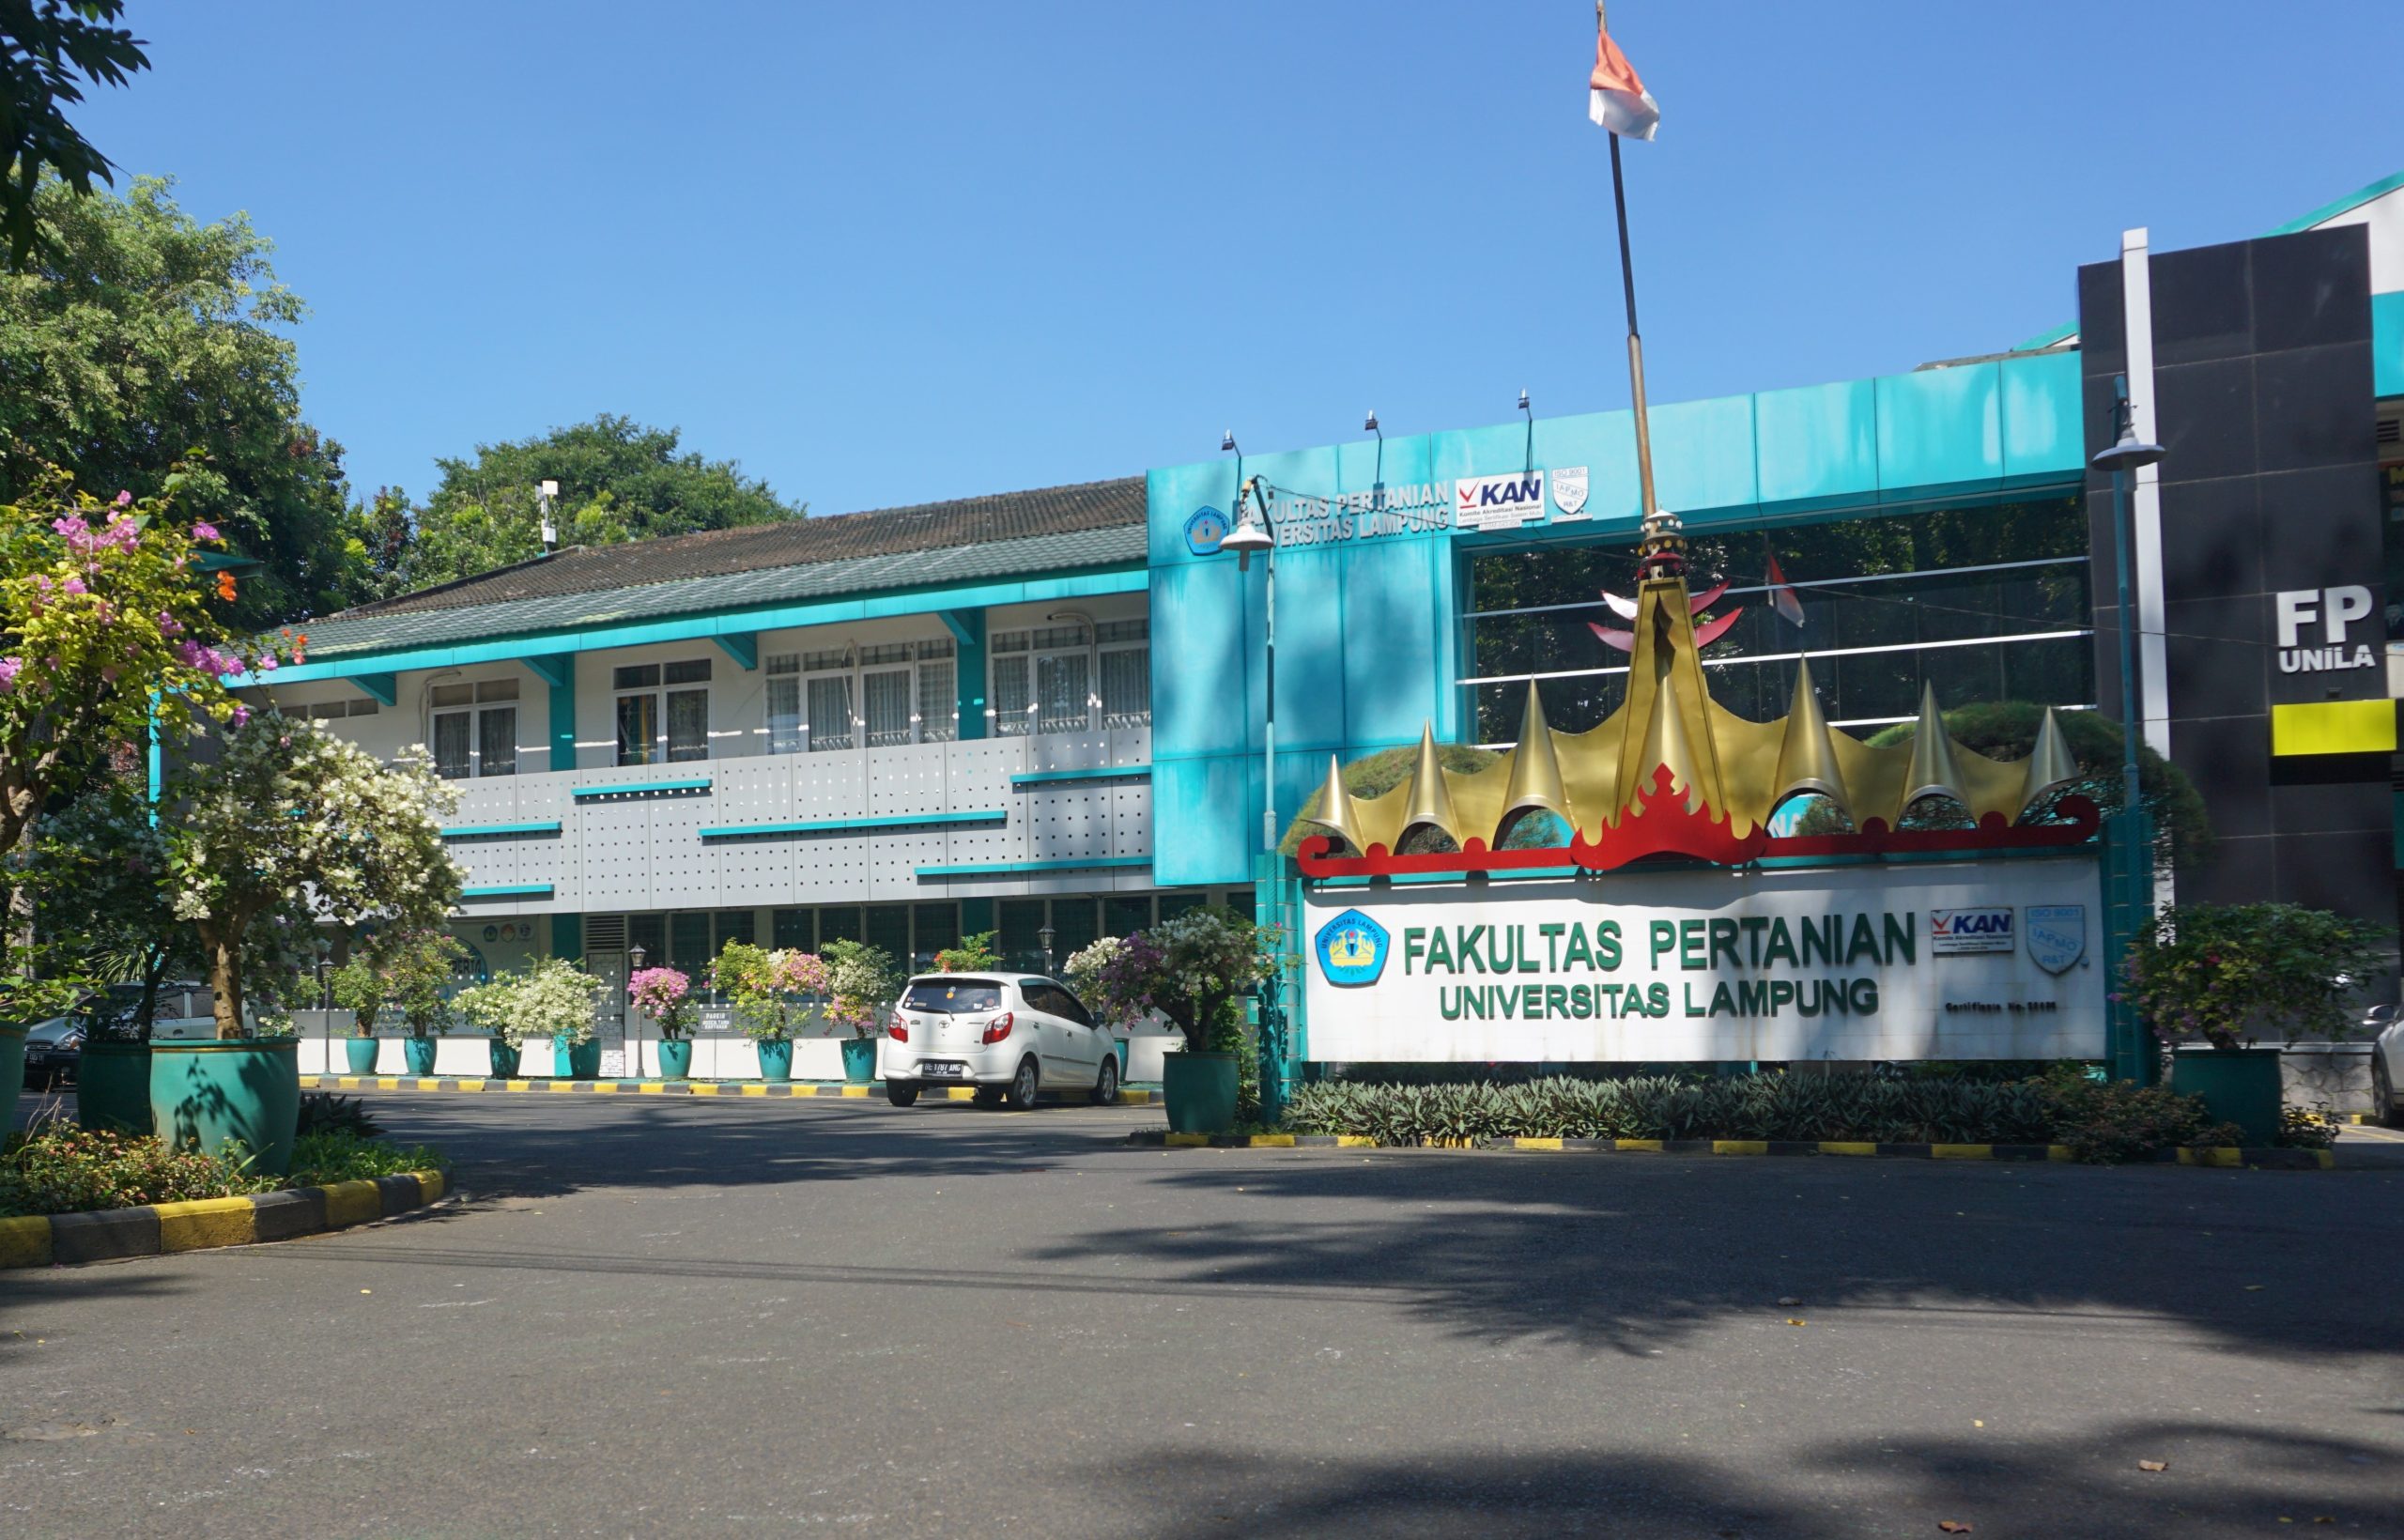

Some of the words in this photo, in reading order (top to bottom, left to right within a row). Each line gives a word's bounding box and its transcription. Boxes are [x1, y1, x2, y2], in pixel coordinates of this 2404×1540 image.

[1336, 480, 1449, 516] PERTANIAN
[1481, 479, 1541, 506] KAN
[1556, 483, 1584, 497] IAPMO
[1361, 507, 1449, 539] LAMPUNG
[1459, 510, 1481, 518] Komite
[1482, 507, 1513, 516] Akreditasi
[1515, 503, 1542, 512] Nasional
[2276, 585, 2373, 647] FP
[2279, 644, 2376, 674] UNILA
[1953, 914, 2011, 934] KAN
[2031, 909, 2052, 917] ISO
[2054, 908, 2079, 917] 9001
[1321, 918, 1356, 948] UNIVERSITAS
[1358, 920, 1383, 948] LAMPUNG
[1404, 920, 1623, 976] FAKULTAS
[1650, 912, 1917, 970] PERTANIAN
[2033, 928, 2077, 951] IAPMO
[1440, 982, 1671, 1020] UNIVERSITAS
[1684, 977, 1879, 1019] LAMPUNG
